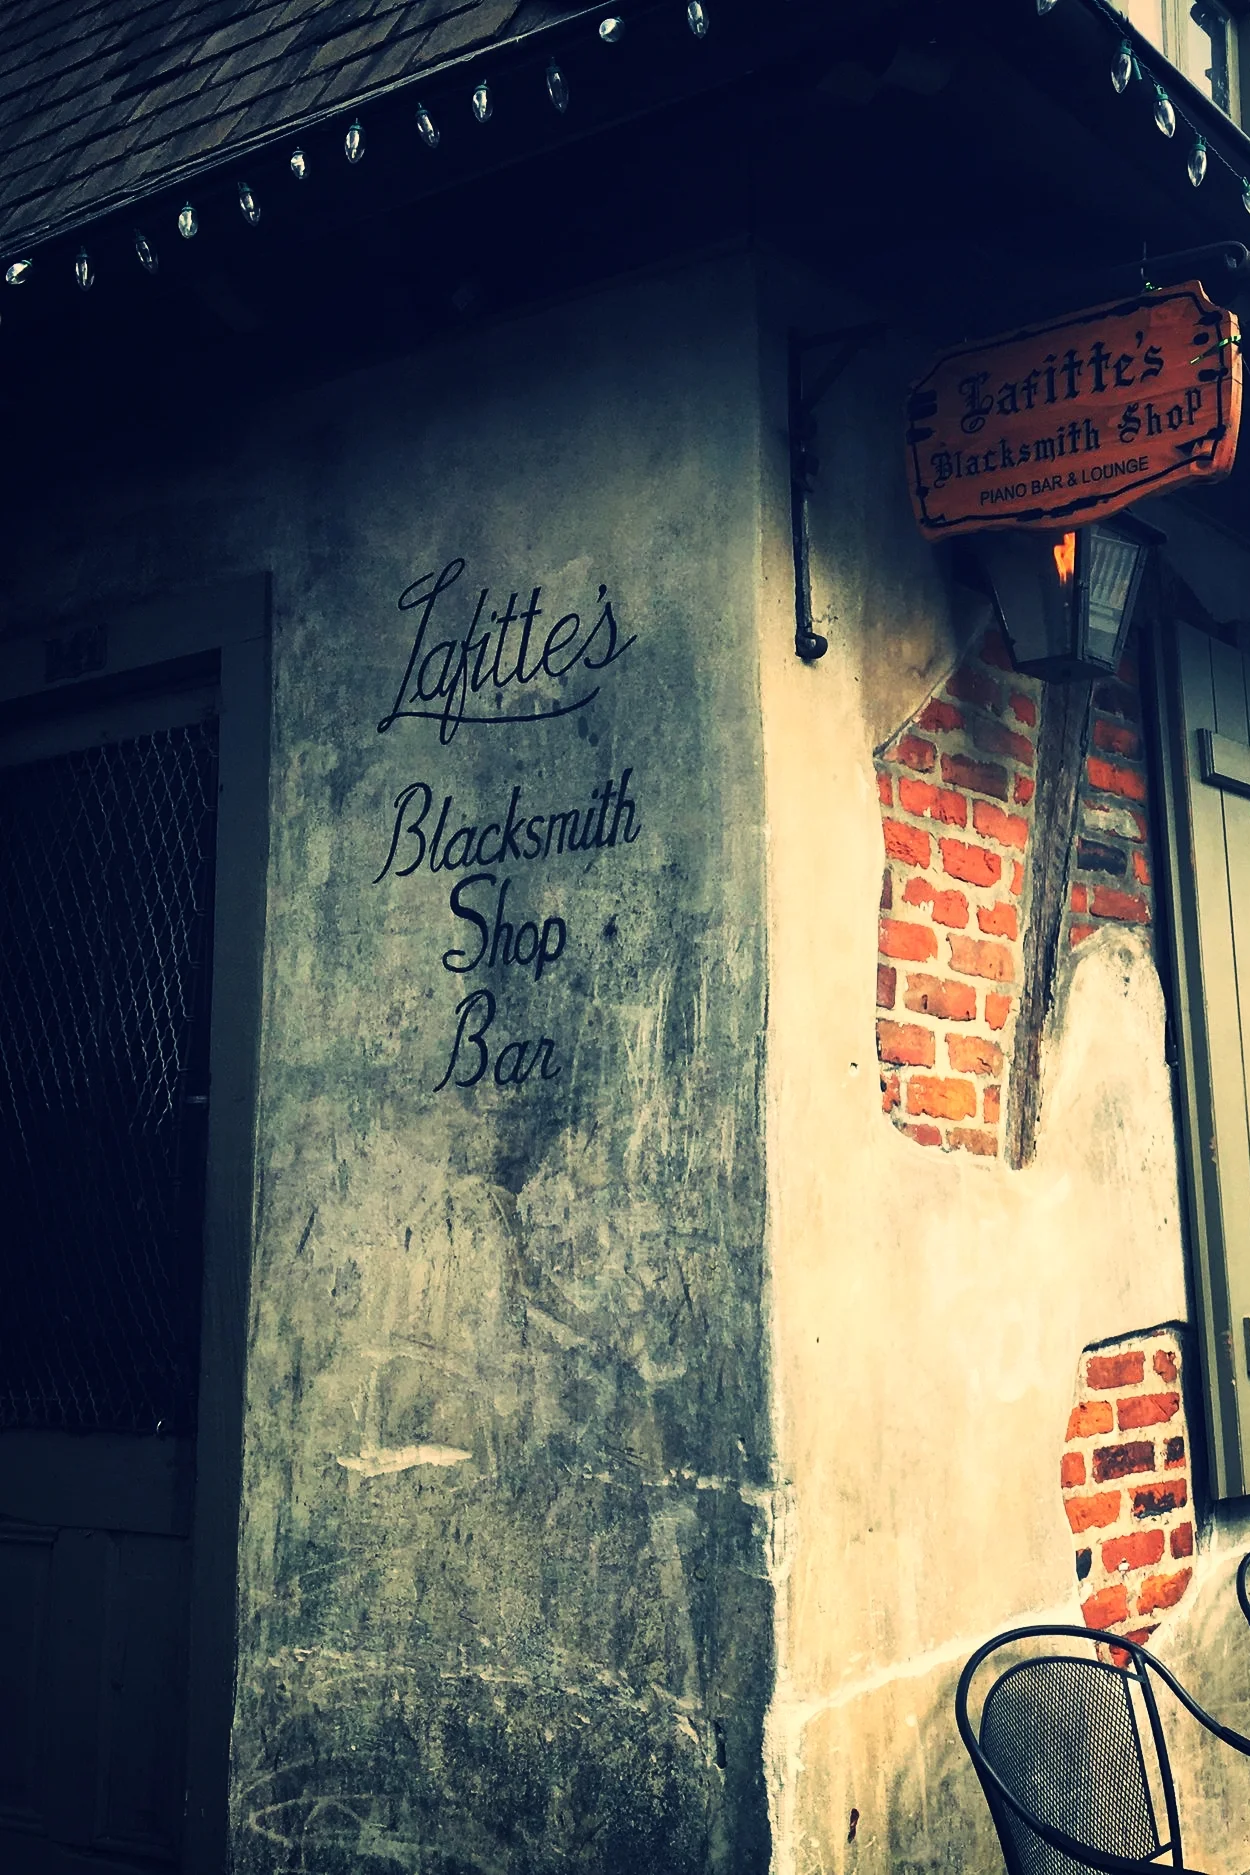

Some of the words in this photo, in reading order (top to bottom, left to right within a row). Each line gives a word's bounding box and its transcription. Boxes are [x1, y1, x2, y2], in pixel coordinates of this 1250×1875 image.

[957, 331, 1165, 434] Lafitte's
[931, 418, 1101, 489] Blacksmith
[1118, 387, 1203, 443] Shop
[980, 484, 1027, 505] PIANO
[1031, 475, 1063, 496] BAR
[1067, 471, 1078, 486] &
[1081, 455, 1149, 484] LOUNGE
[377, 557, 637, 745] Lafitte's
[373, 768, 641, 884] Blacksmith
[442, 873, 567, 982] Shop
[434, 989, 561, 1093] Bar
